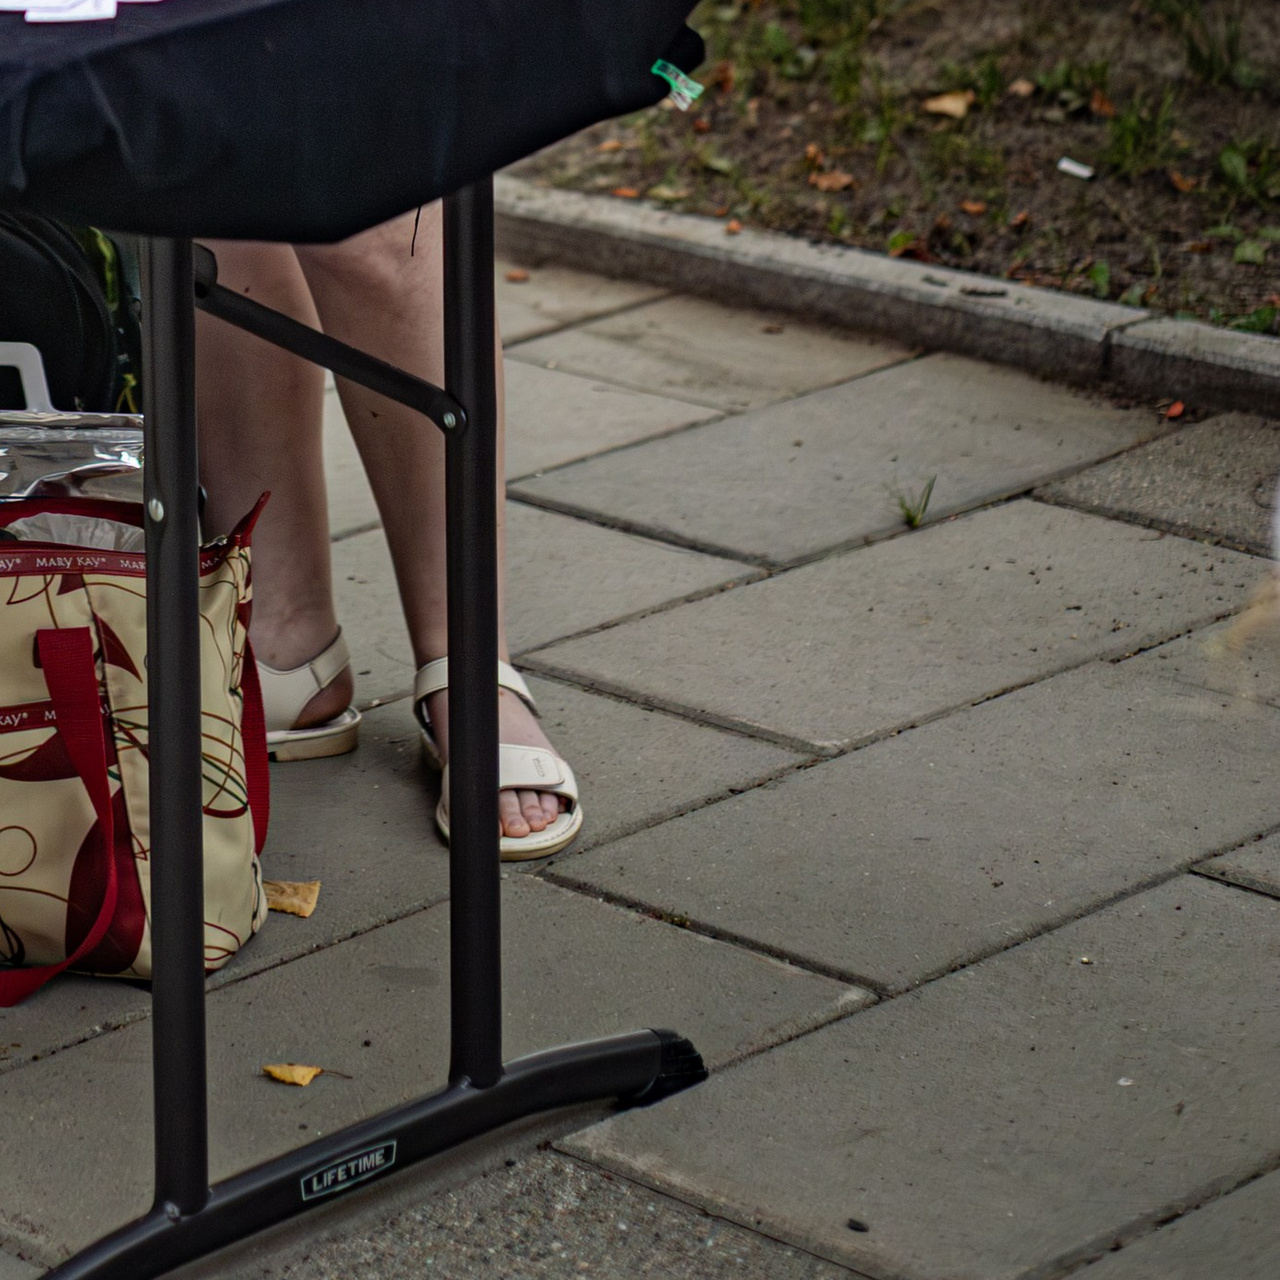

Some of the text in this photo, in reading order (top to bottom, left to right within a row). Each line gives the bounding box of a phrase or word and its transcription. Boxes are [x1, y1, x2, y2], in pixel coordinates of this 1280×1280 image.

[36, 556, 71, 569] MARY
[120, 559, 146, 571] MAR
[312, 1148, 385, 1192] LIFETIME
